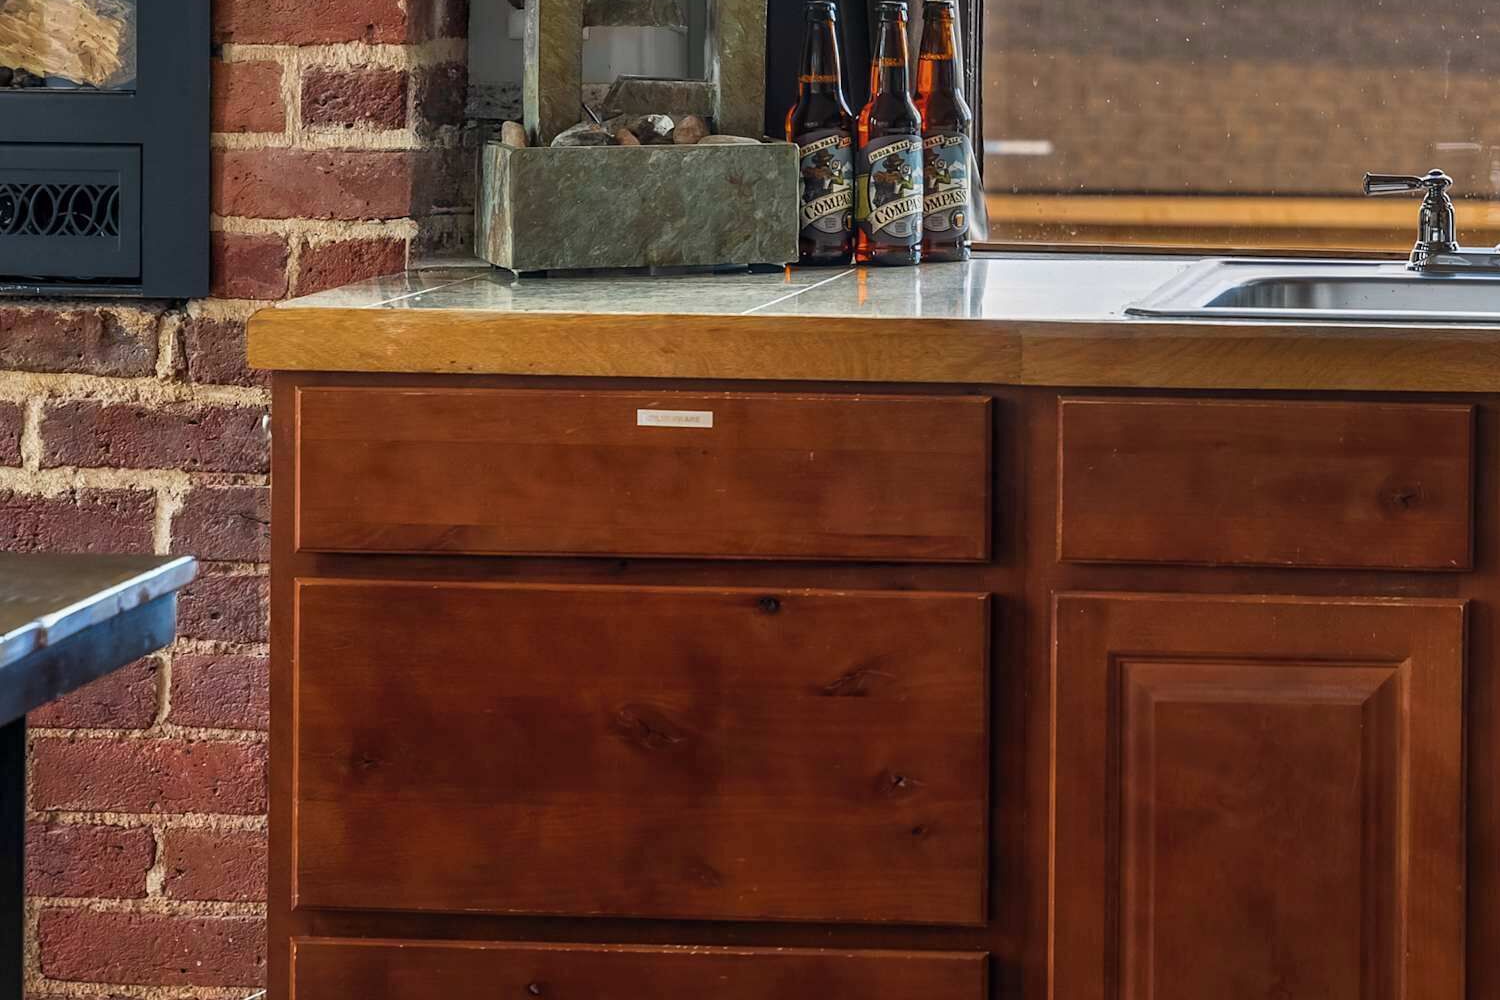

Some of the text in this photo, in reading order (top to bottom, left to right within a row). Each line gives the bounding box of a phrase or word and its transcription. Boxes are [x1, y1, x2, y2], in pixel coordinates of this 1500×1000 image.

[801, 143, 820, 156] NDIA
[870, 146, 891, 161] INDIA
[891, 141, 908, 152] PALE
[804, 192, 852, 220] COMPAS
[923, 190, 966, 212] OMPASS
